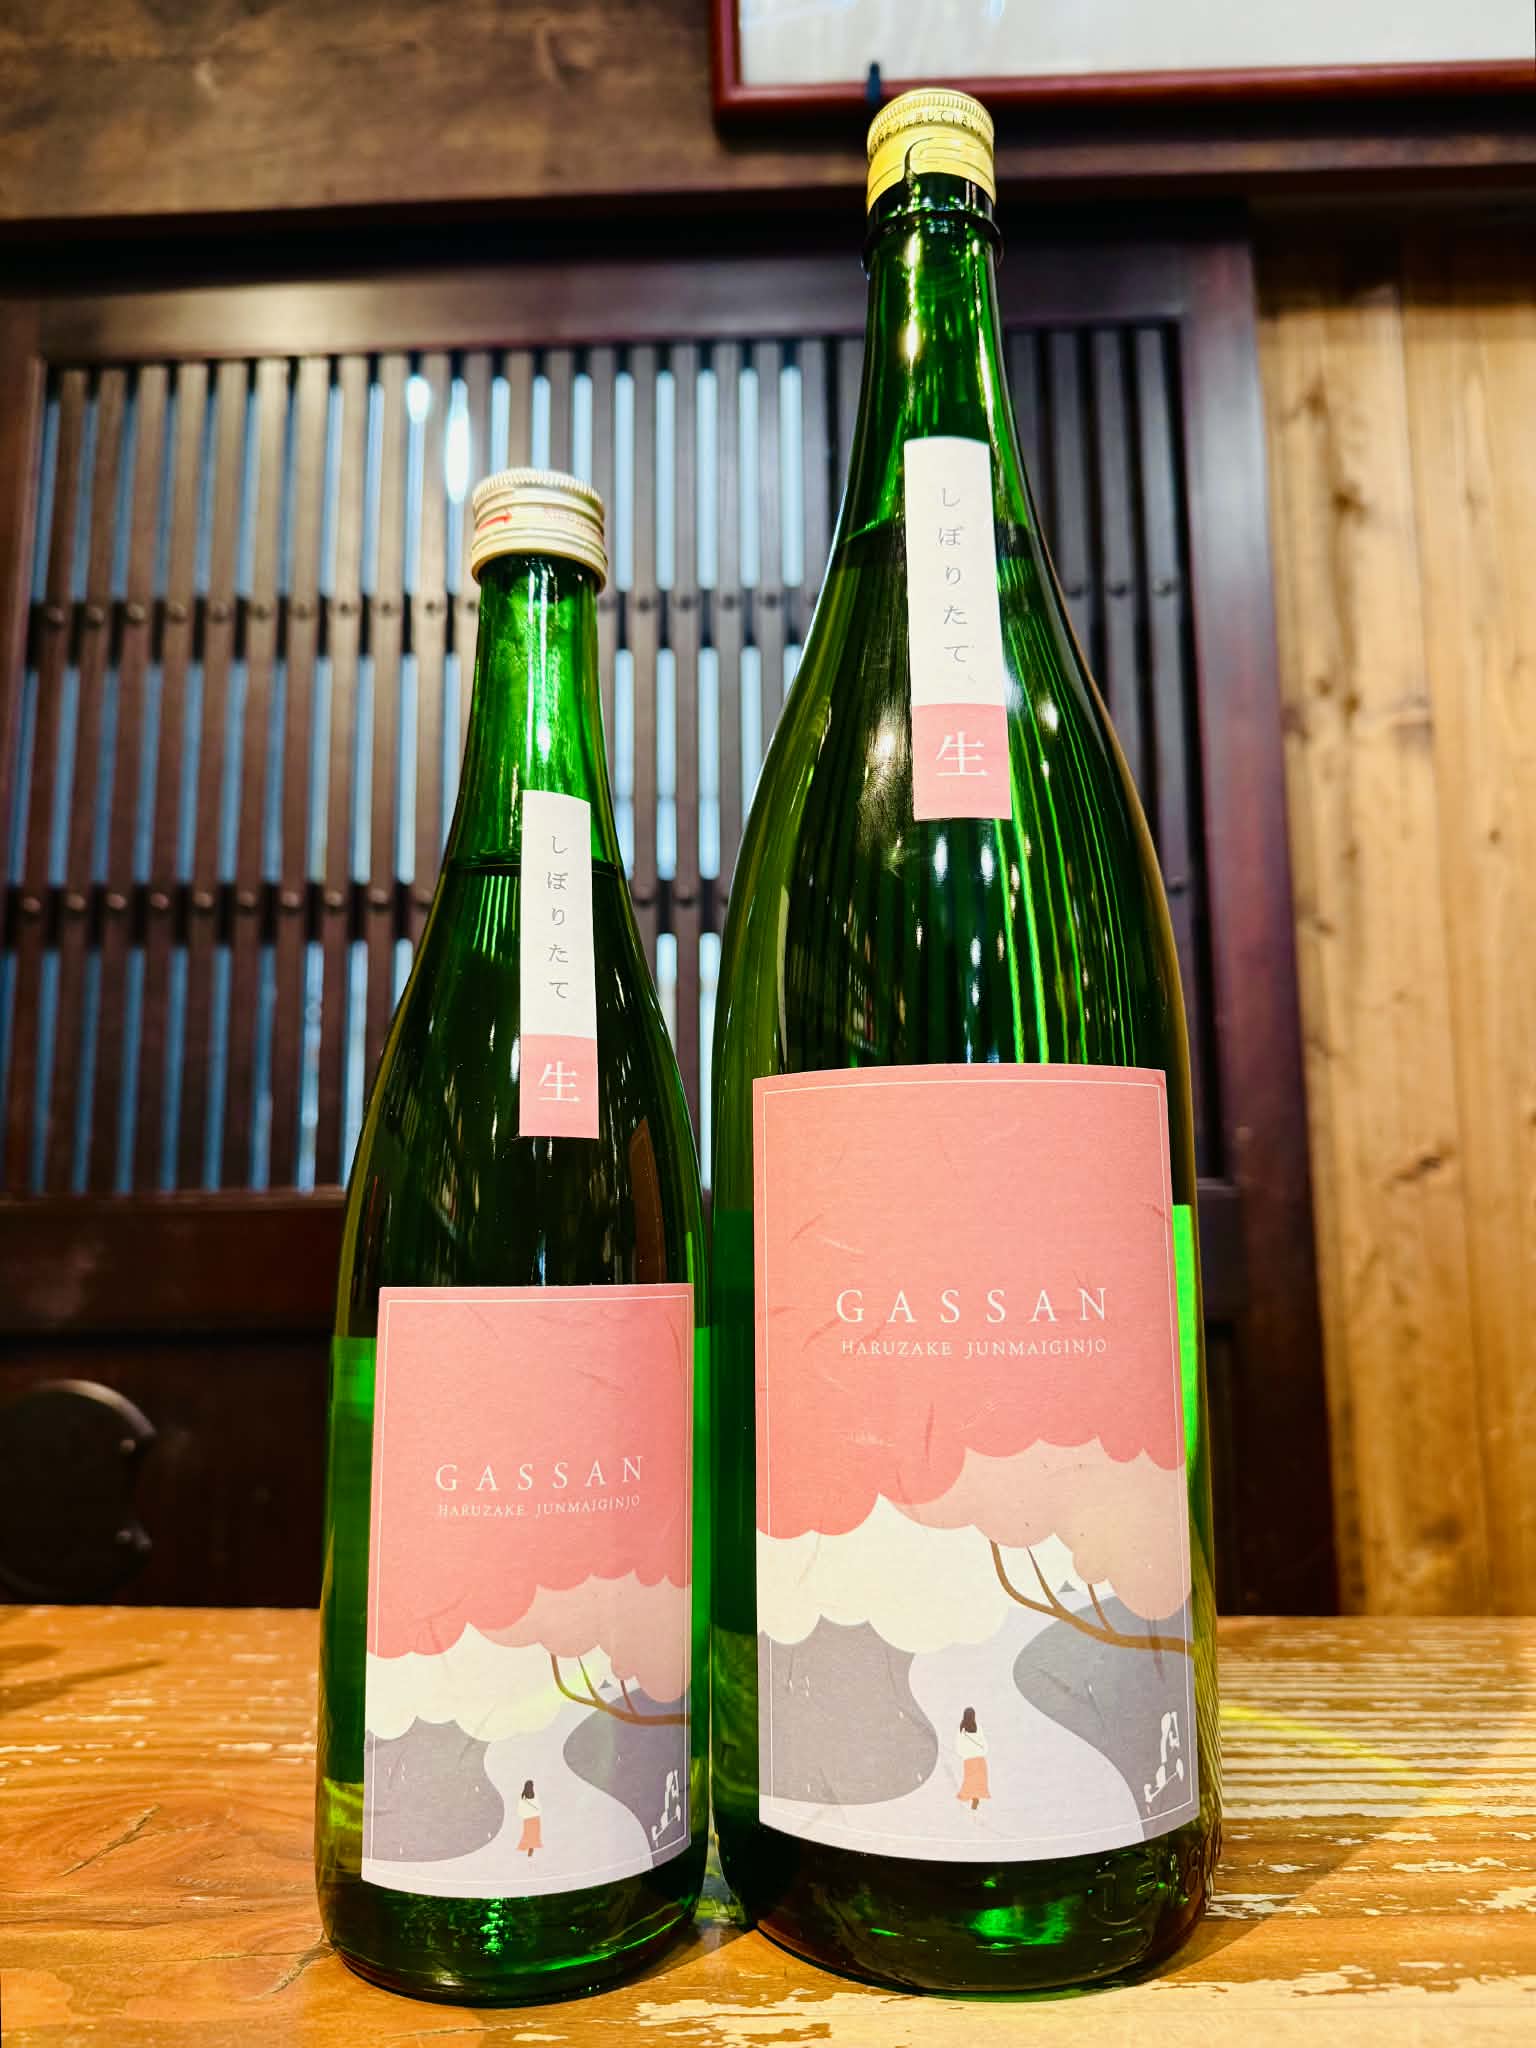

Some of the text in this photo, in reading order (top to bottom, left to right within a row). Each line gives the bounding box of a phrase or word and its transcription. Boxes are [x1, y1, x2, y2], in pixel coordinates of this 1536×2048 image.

[937, 487, 968, 663] しぼりたて
[935, 731, 989, 777] 生
[546, 834, 569, 999] しぼりたて
[537, 1059, 581, 1103] 生
[835, 1287, 1107, 1324] GASSAN
[841, 1337, 1107, 1359] HARUZAKE JUNMAIGINJO
[434, 1455, 643, 1491] GASSAN
[438, 1494, 641, 1519] HARUZAKE JUNMAIGINJO
